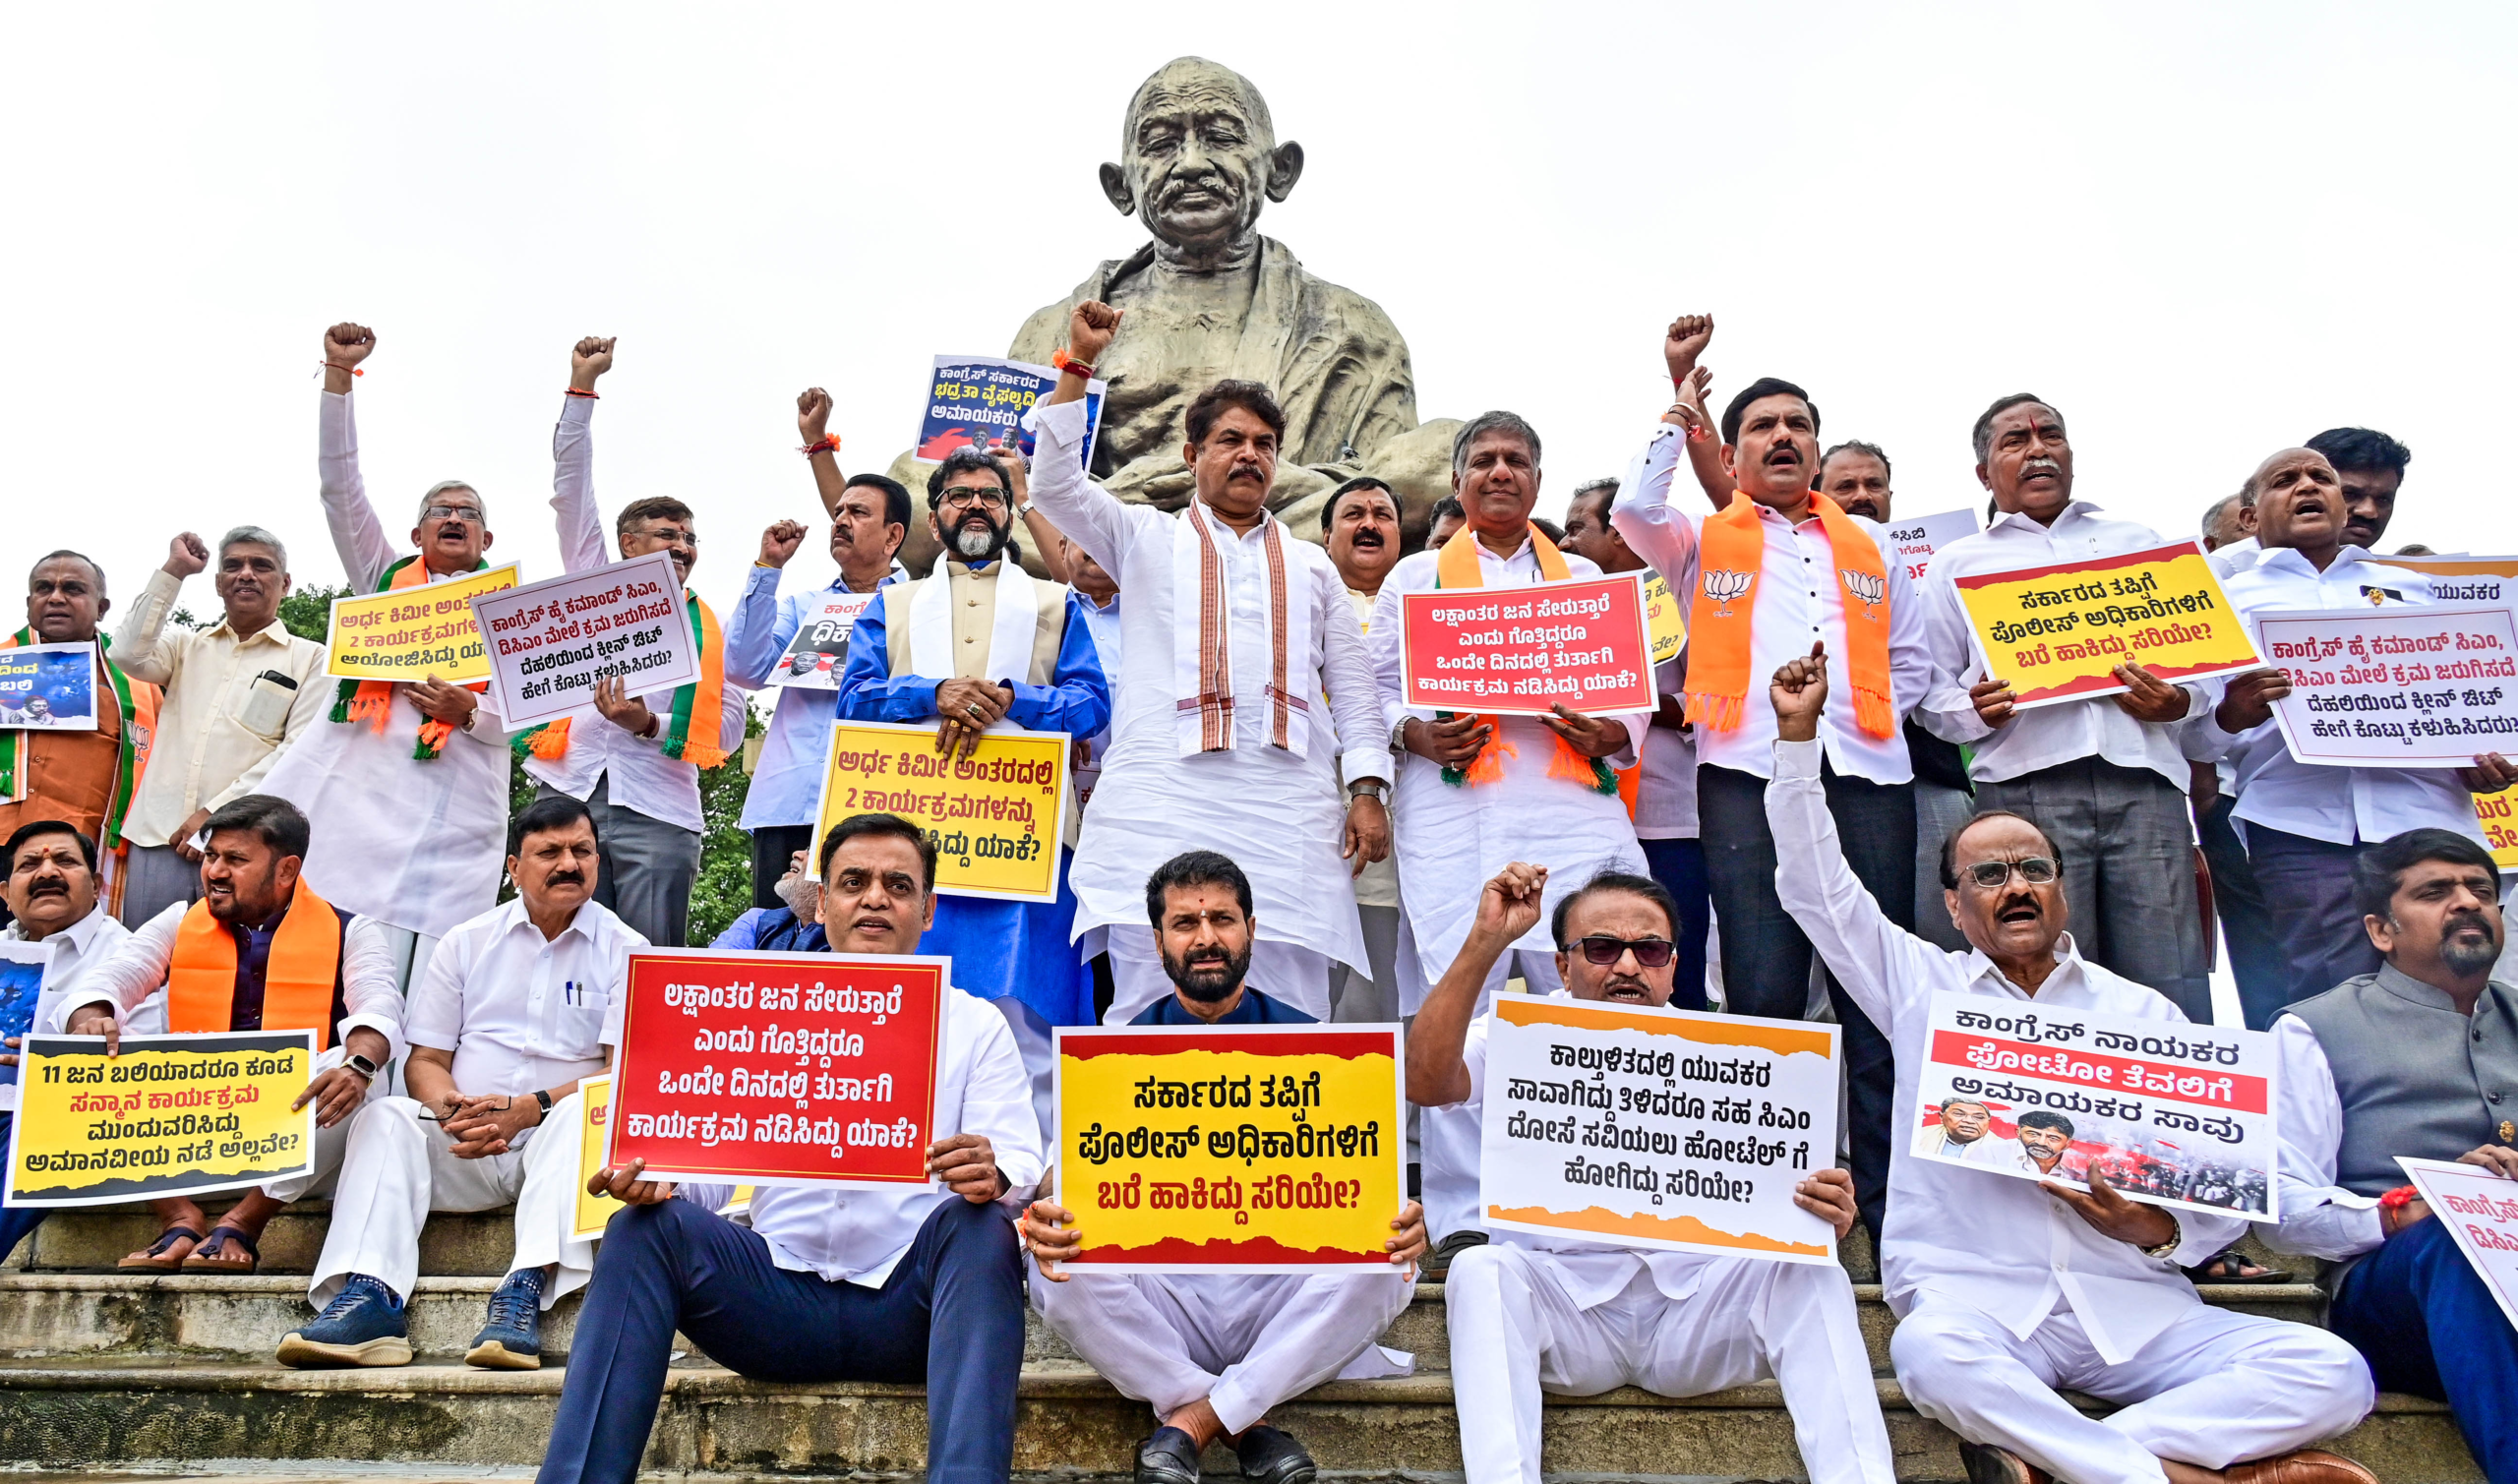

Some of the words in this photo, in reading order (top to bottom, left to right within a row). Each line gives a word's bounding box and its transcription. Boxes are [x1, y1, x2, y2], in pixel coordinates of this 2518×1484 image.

[940, 368, 987, 382] ಕಾಂಗ್ರೆಸ್
[989, 371, 1040, 388] ಸರ್ಕಾರದ
[931, 404, 1018, 427] ಅಮಾಯಕರು
[491, 605, 545, 633] ಕಾಂಗ್ರೆಸ್
[548, 601, 567, 623] ಹೈ
[565, 586, 623, 613] ಕಮಾಂಡ್
[627, 580, 662, 599] ಸಿಎಂ,
[1432, 604, 1499, 627] ಲಕ್ಷಾಂತರ
[1503, 602, 1532, 620] ಜನ
[1536, 593, 1610, 622] ಸೇರುತ್ತಾರೆ
[2018, 580, 2107, 610] ಸರ್ಕಾರದ
[2109, 571, 2158, 599] ತಪ್ಪಿಗೆ
[2085, 590, 2214, 627] ಅಧಿಕಾರಿಗಳಿಗೆ
[340, 611, 385, 629] ಅರ್ಧ
[390, 604, 431, 623] ಕಿಮೀ
[499, 633, 542, 656] ಡಿಸಿಎಂ
[545, 622, 580, 644] ಮೇಲೆ
[583, 615, 611, 638] ಕ್ರಮ
[613, 598, 672, 627] ಜರುಗಿಸದೆ
[349, 635, 359, 647] 2
[597, 633, 630, 662] ಕ್ಲೀನ್
[632, 626, 663, 647] ಚಿಟ್
[1459, 629, 1504, 646] ಎಂದು
[1509, 624, 1587, 650] ಗೊತ್ತಿದ್ದರೂ
[2015, 643, 2051, 668] ಬರೆ
[2055, 635, 2135, 661] ಹಾಕಿದ್ದು
[2129, 623, 2212, 650] ಸರಿಯೇ?
[2272, 636, 2343, 662] ಕಾಂಗ್ರೆಸ್
[2348, 634, 2370, 664] ಹೈ
[2370, 632, 2449, 654] ಕಮಾಂಡ್
[2455, 632, 2503, 651] ಸಿಎಂ,
[340, 646, 458, 668] ಆಯೋಜಿಸಿದ್ದು
[1436, 652, 1485, 670] ಒಂದೇ
[1490, 652, 1551, 675] ದಿನದಲ್ಲಿ
[1553, 647, 1614, 668] ತುರ್ತಾಗಿ
[2340, 663, 2388, 684] ಮೇಲೆ
[2392, 664, 2430, 686] ಕ್ರಮ
[2434, 656, 2516, 680] ಜರುಗಿಸದೆ
[521, 677, 552, 700] ಹೇಗೆ
[554, 671, 595, 692] ಕೊಟ್ಟು
[1417, 677, 1509, 696] ಕಾರ್ಯಕ್ರಮ
[1584, 670, 1637, 690] ಯಾಕೆ?
[2307, 691, 2407, 712] ದೆಹಲಿಯಿಂದ
[2412, 688, 2457, 716] ಕ್ಲೀನ್
[2461, 686, 2503, 706] ಚಿಟ್
[2310, 719, 2351, 739] ಹೇಗೆ
[2354, 720, 2413, 745] ಕೊಟ್ಟು
[838, 749, 892, 778] ಅರ್ಧ
[897, 752, 948, 778] ಕಿಮೀ
[954, 757, 1053, 795] ಅಂತರದಲ್ಲಿ
[845, 788, 857, 807] 2
[863, 789, 1035, 834] ಕಾರ್ಯಕ್ರಮಗಳನ್ನು
[975, 833, 1041, 861] ಯಾಕೆ?
[665, 981, 754, 1018] ಲಕ್ಷಾಂತರ
[759, 983, 799, 1011] ಜನ
[805, 981, 903, 1026] ಸೇರುತ್ತಾರೆ
[694, 1026, 754, 1052] ಎಂದು
[760, 1023, 865, 1068] ಗೊತ್ತಿದ್ದರೂ
[1955, 1009, 2085, 1043] ಕಾಂಗ್ರೆಸ್
[2094, 1030, 2240, 1066] ನಾಯಕರ
[41, 1065, 61, 1084] 11
[67, 1063, 104, 1084] ಜನ
[111, 1058, 239, 1083] ಬಲಿಯಾದರೂ
[246, 1055, 294, 1077] ಕೂಡ
[1550, 1043, 1676, 1088] ಕಾಲ್ತುಳಿತದಲ್ಲಿ
[1681, 1054, 1771, 1088] ಯುವಕರ
[1965, 1041, 2113, 1084] ಫೋಟೋ
[2122, 1065, 2234, 1102] ತೆವಲಿಗೆ
[70, 1090, 142, 1121] ಸನ್ಮಾನ
[148, 1084, 260, 1110] ಕಾರ್ಯಕ್ರಮ
[659, 1065, 724, 1096] ಒಂದೇ
[730, 1068, 809, 1109] ದಿನದಲ್ಲಿ
[812, 1072, 893, 1102] ತುರ್ತಾಗಿ
[1134, 1074, 1251, 1108] ಸರ್ಕಾರದ
[1260, 1070, 1321, 1122] ತಪ್ಪಿಗೆ
[1507, 1077, 1616, 1122] ಸಾವಾಗಿದ್ದು
[1619, 1087, 1706, 1119] ತಿಳಿದರೂ
[1711, 1097, 1751, 1125] ಸಹ
[1758, 1102, 1811, 1131] ಸಿಎಂ
[88, 1111, 242, 1141] ಮುಂದುವರಿಸಿದ್ದು
[628, 1110, 748, 1148] ಕಾರ್ಯಕ್ರಮ
[847, 1116, 918, 1149] ಯಾಕೆ?
[1951, 1076, 2143, 1122] ಅಮಾಯಕರ
[2153, 1107, 2245, 1145] ಸಾವು
[26, 1145, 170, 1172] ಅಮಾನವೀಯ
[177, 1139, 212, 1163] ನಡೆ
[220, 1133, 299, 1162] ಅಲ್ಲವೇ?
[1079, 1122, 1200, 1165] ಪೊಲೀಸ್
[1208, 1121, 1379, 1166] ಅಧಿಕಾರಿಗಳಿಗೆ
[1507, 1109, 1576, 1144] ದೋಸೆ
[1582, 1119, 1677, 1156] ಸವಿಯಲು
[1685, 1130, 1786, 1166] ಹೋಟೆಲ್
[1792, 1141, 1809, 1170] ಗೆ
[1098, 1172, 1141, 1210] ಬರೆ
[1150, 1175, 1248, 1225] ಹಾಕಿದ್ದು
[1251, 1171, 1361, 1210] ಸರಿಯೇ?
[1564, 1155, 1663, 1205] ಹೋಗಿದ್ದು
[1665, 1168, 1754, 1204] ಸರಿಯೇ?
